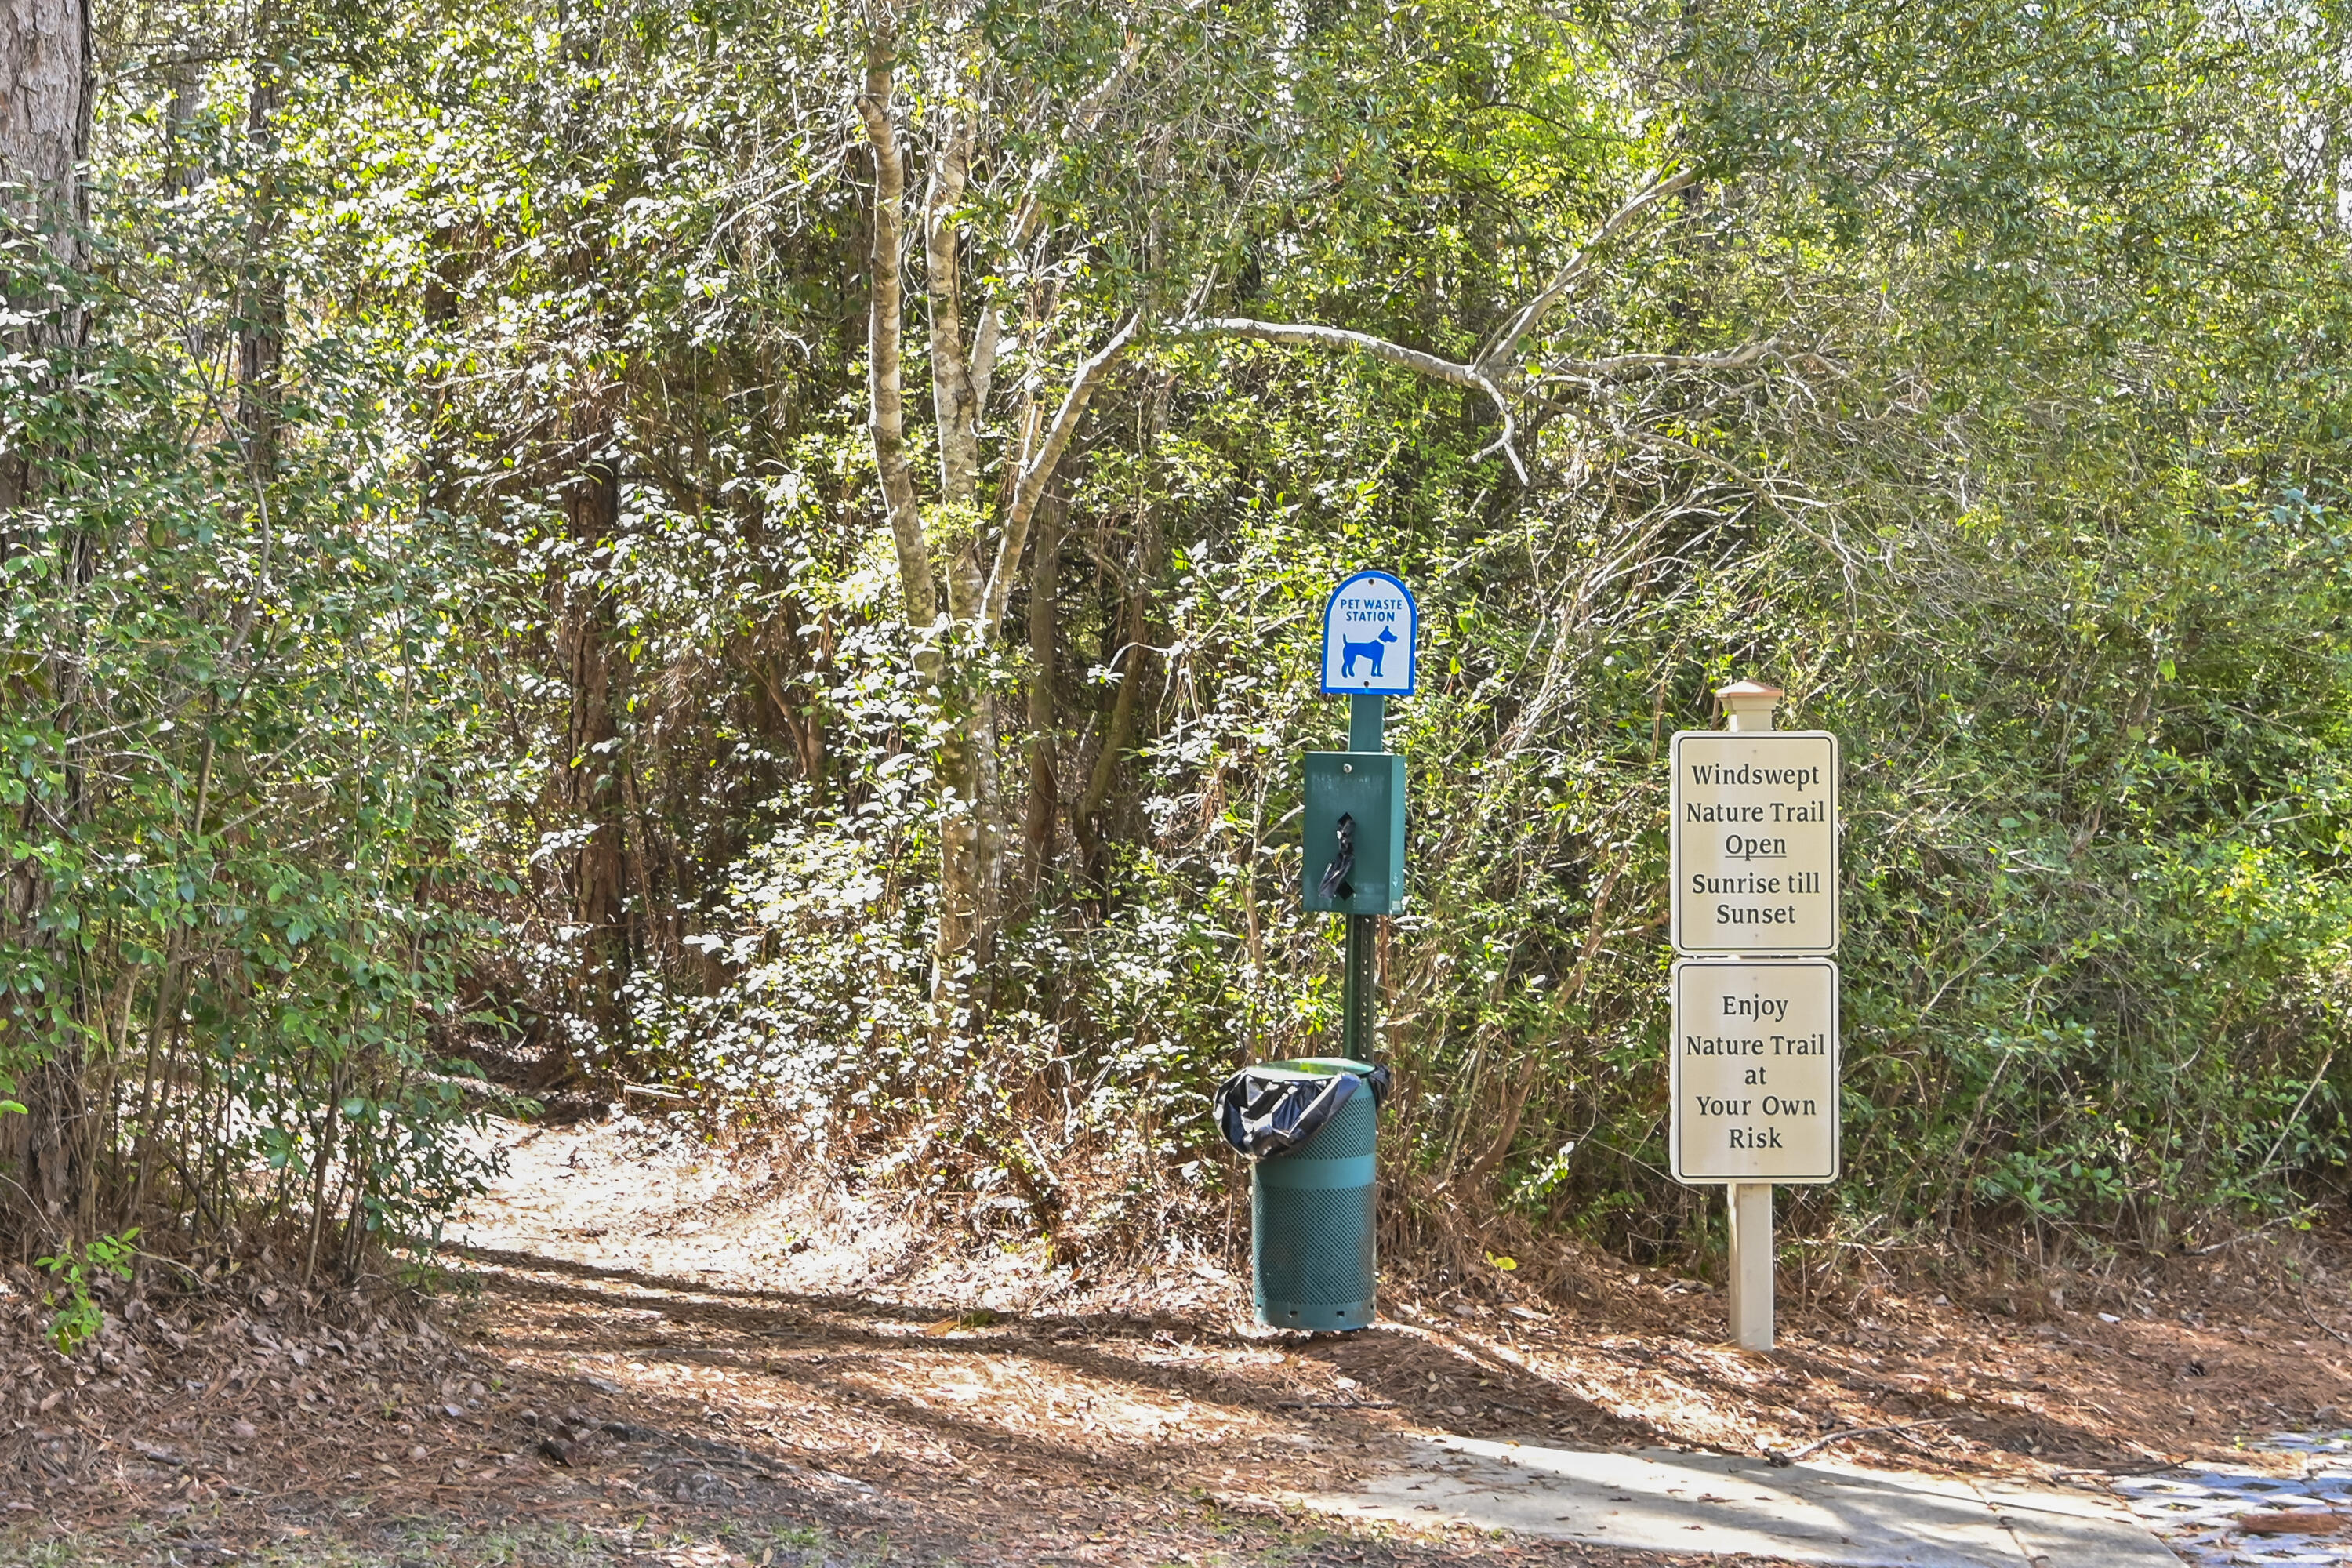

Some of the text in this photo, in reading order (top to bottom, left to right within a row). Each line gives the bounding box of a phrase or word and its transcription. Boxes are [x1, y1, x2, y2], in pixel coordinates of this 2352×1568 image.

[1341, 599, 1402, 609] PET WASTE
[1346, 611, 1395, 622] STATION
[1692, 764, 1819, 791] Windswept
[1687, 800, 1824, 822] Nature Trail
[1726, 835, 1787, 861] Open
[1693, 872, 1819, 894] Sunrise till
[1717, 905, 1795, 924] Sunset
[1723, 993, 1788, 1022] Enjoy
[1687, 1034, 1824, 1055] Nature Trail
[1745, 1067, 1766, 1085] at
[1696, 1096, 1816, 1116] Your Own
[1730, 1127, 1782, 1148] Risk
